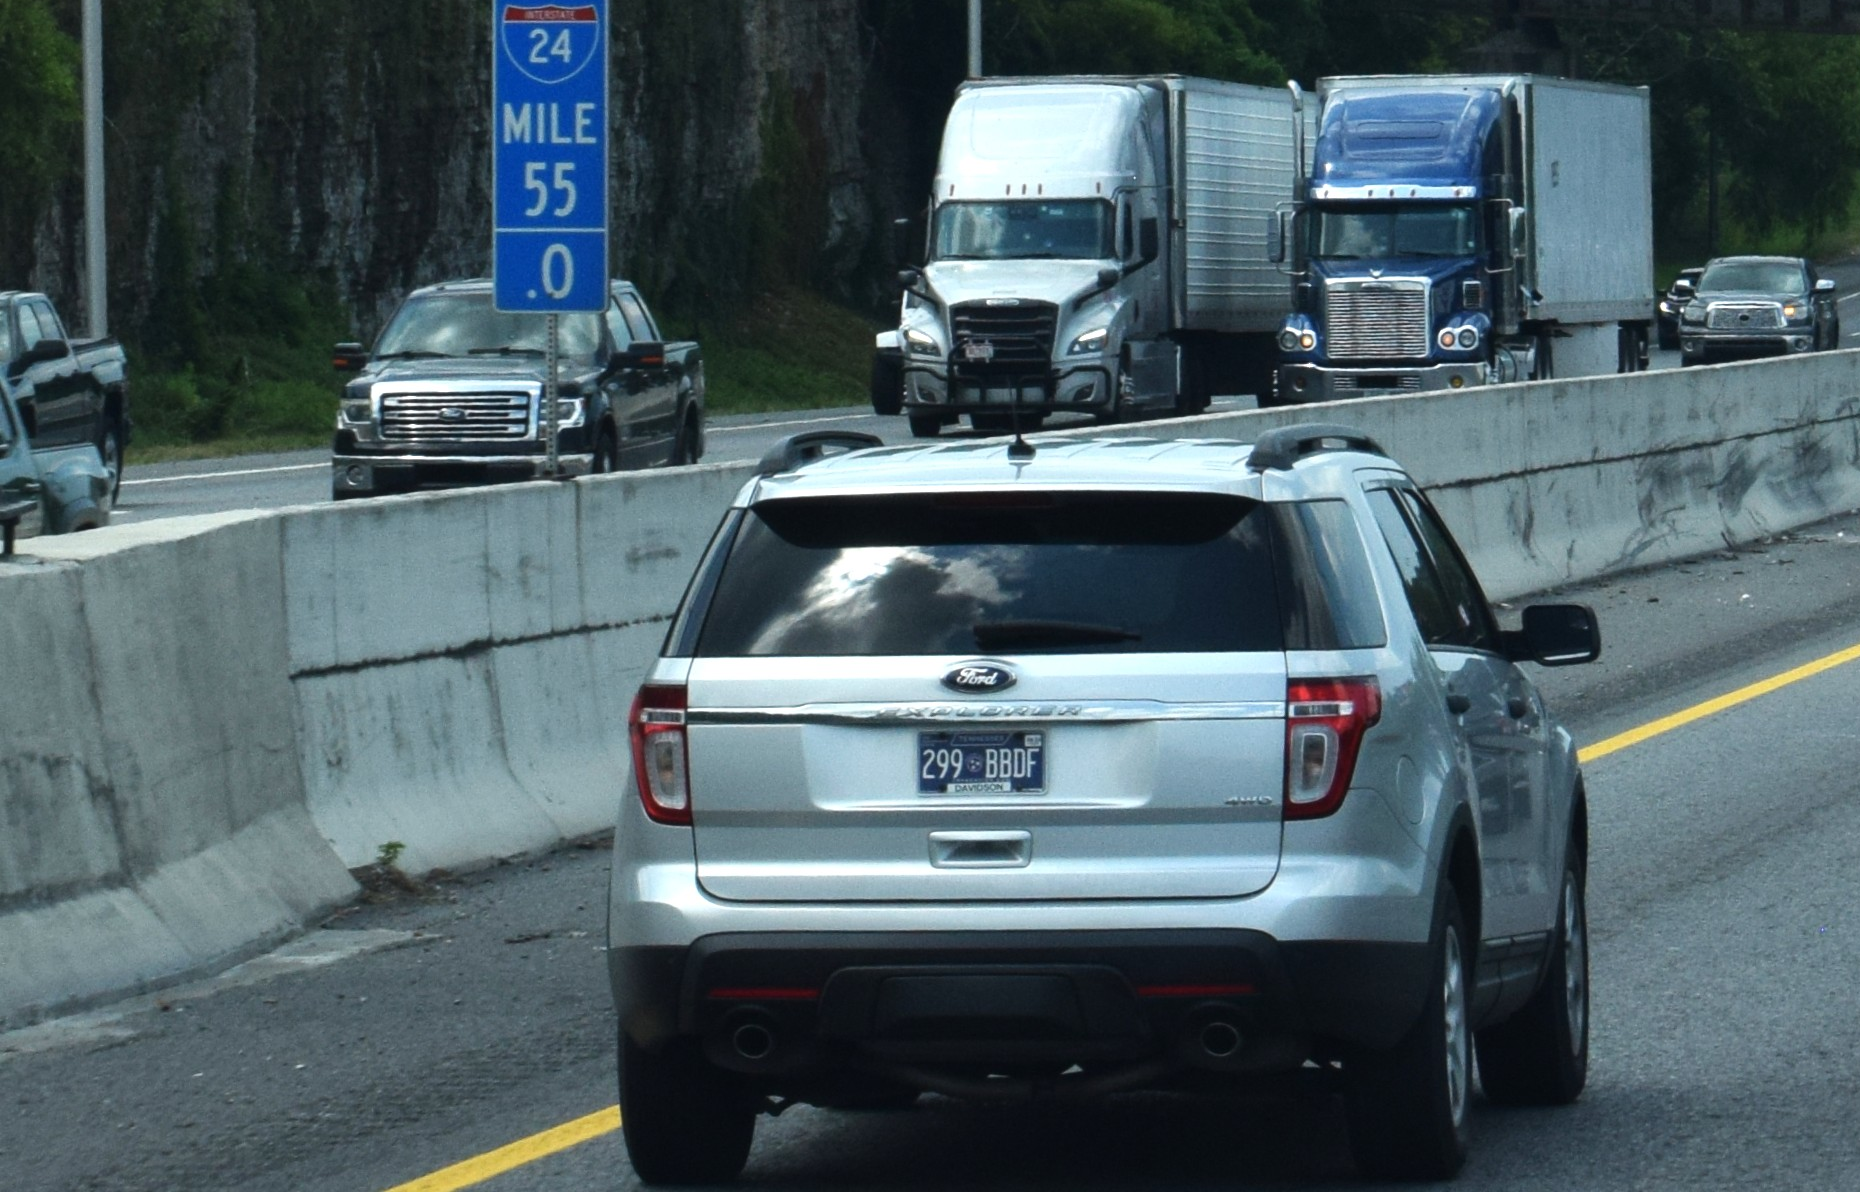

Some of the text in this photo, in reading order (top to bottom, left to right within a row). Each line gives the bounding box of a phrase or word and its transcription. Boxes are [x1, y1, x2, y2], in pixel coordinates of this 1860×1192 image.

[524, 10, 576, 21] INTERSTATE
[528, 28, 572, 64] 24
[503, 103, 597, 145] MILE
[524, 162, 577, 218] 55
[956, 667, 998, 685] Ford
[876, 705, 1082, 718] EXPLORER
[922, 748, 1040, 779] 299 BBDF
[954, 784, 1004, 792] DAVIDSON
